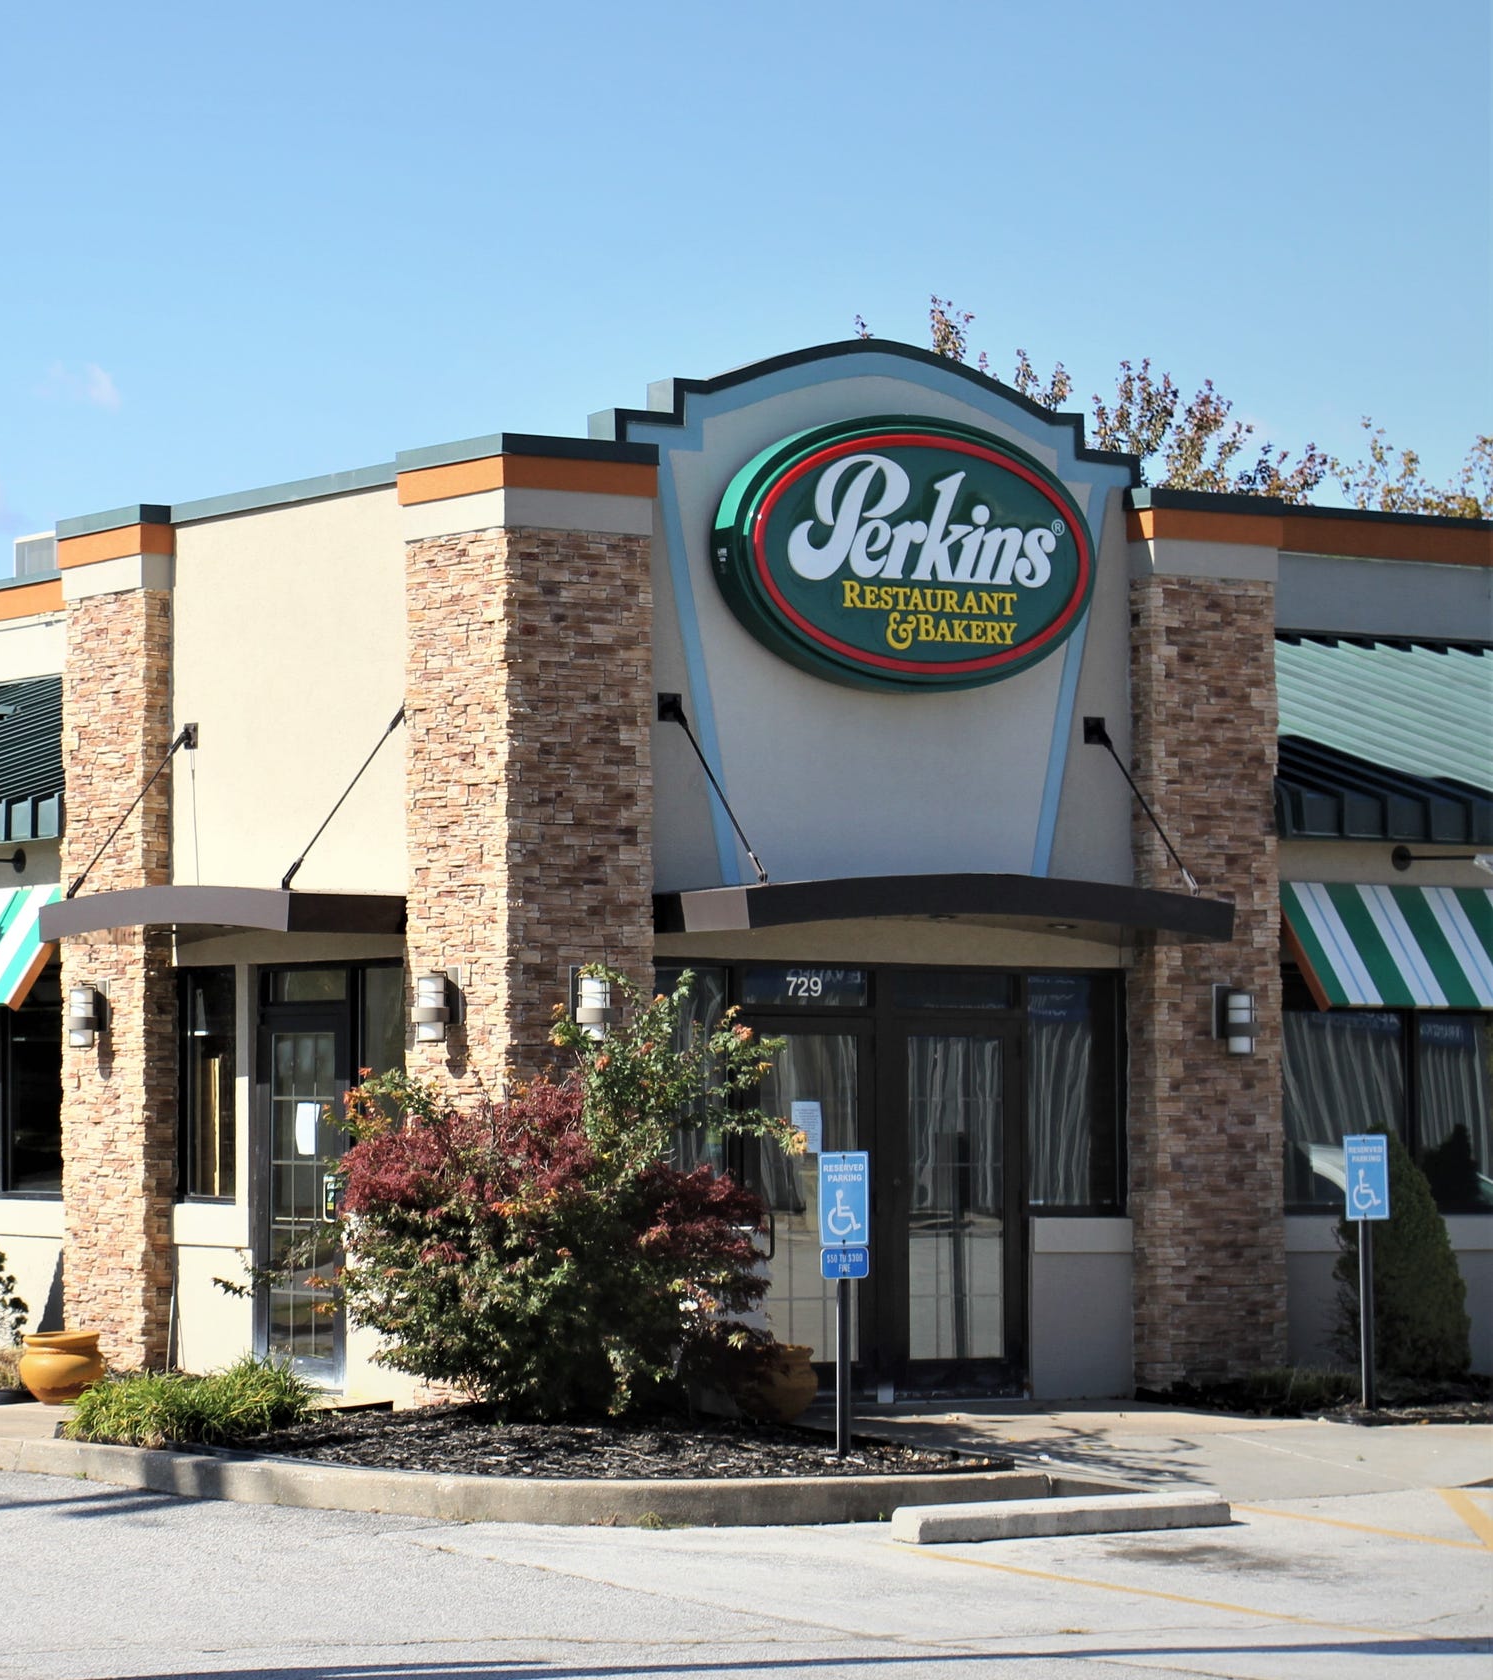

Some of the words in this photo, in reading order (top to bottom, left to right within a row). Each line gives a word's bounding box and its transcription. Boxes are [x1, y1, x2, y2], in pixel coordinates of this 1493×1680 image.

[842, 581, 1018, 616] RESTAURANT
[786, 977, 822, 997] 729
[822, 1163, 864, 1173] RESERVED
[827, 1174, 863, 1183] PARKING
